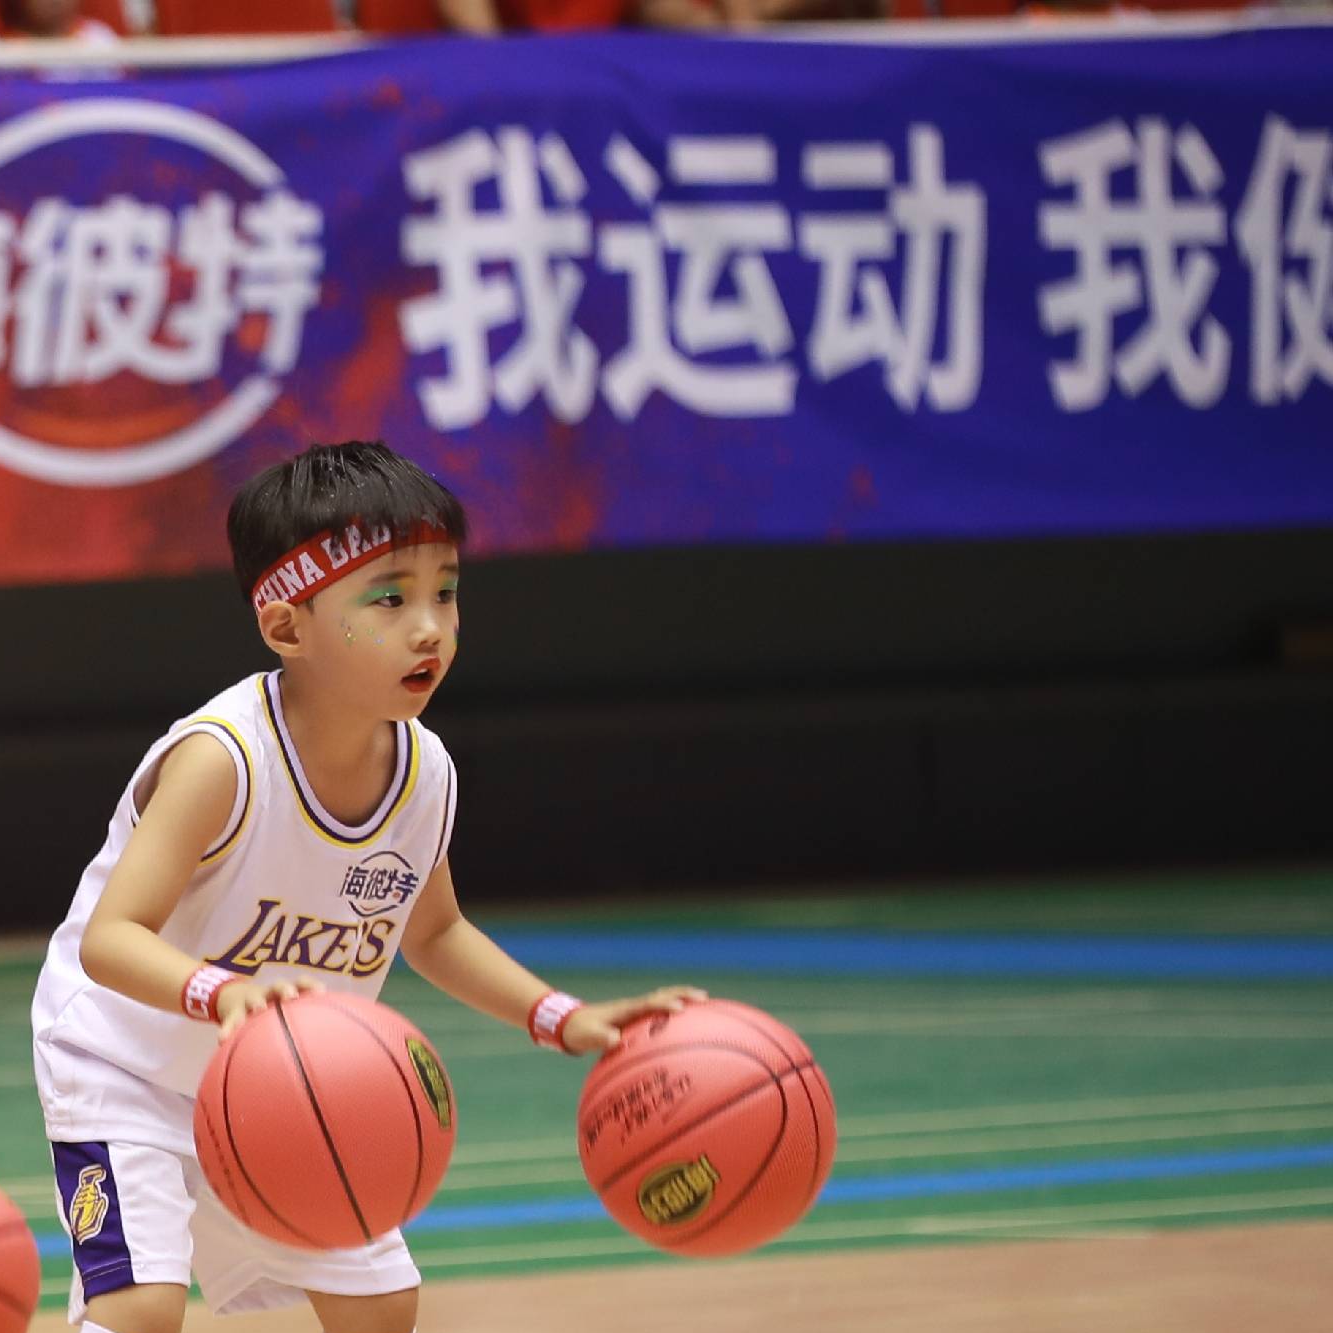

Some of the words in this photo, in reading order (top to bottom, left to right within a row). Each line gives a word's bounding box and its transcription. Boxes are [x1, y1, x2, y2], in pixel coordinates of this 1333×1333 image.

[398, 122, 987, 432] 我运动
[339, 865, 420, 904] 海彼特
[202, 898, 396, 978] LAKES
